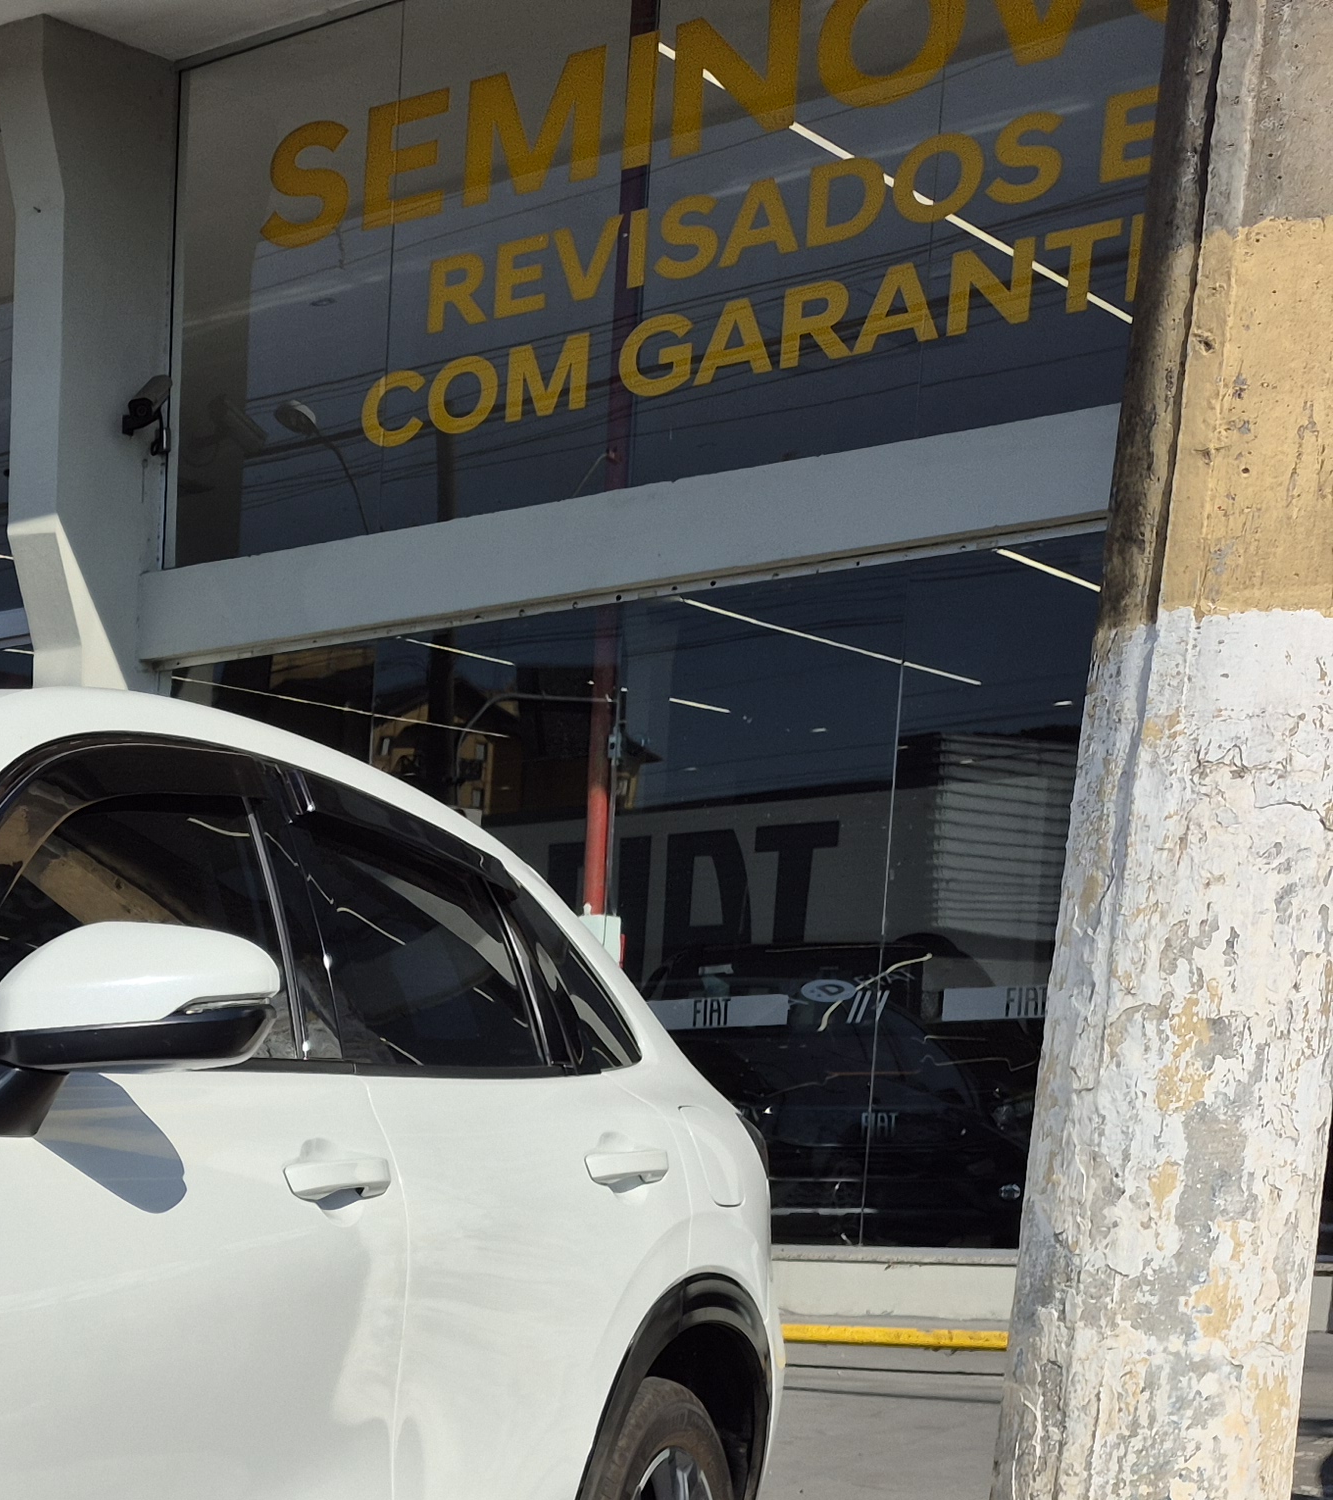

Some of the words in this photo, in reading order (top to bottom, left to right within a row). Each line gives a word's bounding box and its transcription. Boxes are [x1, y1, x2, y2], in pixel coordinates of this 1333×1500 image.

[258, 0, 1166, 247] SEMINOV
[424, 110, 1063, 333] REVISADOS
[1097, 84, 1160, 184] E
[360, 330, 590, 448] COM
[618, 213, 1146, 398] GARANTI
[693, 998, 732, 1027] FIAT
